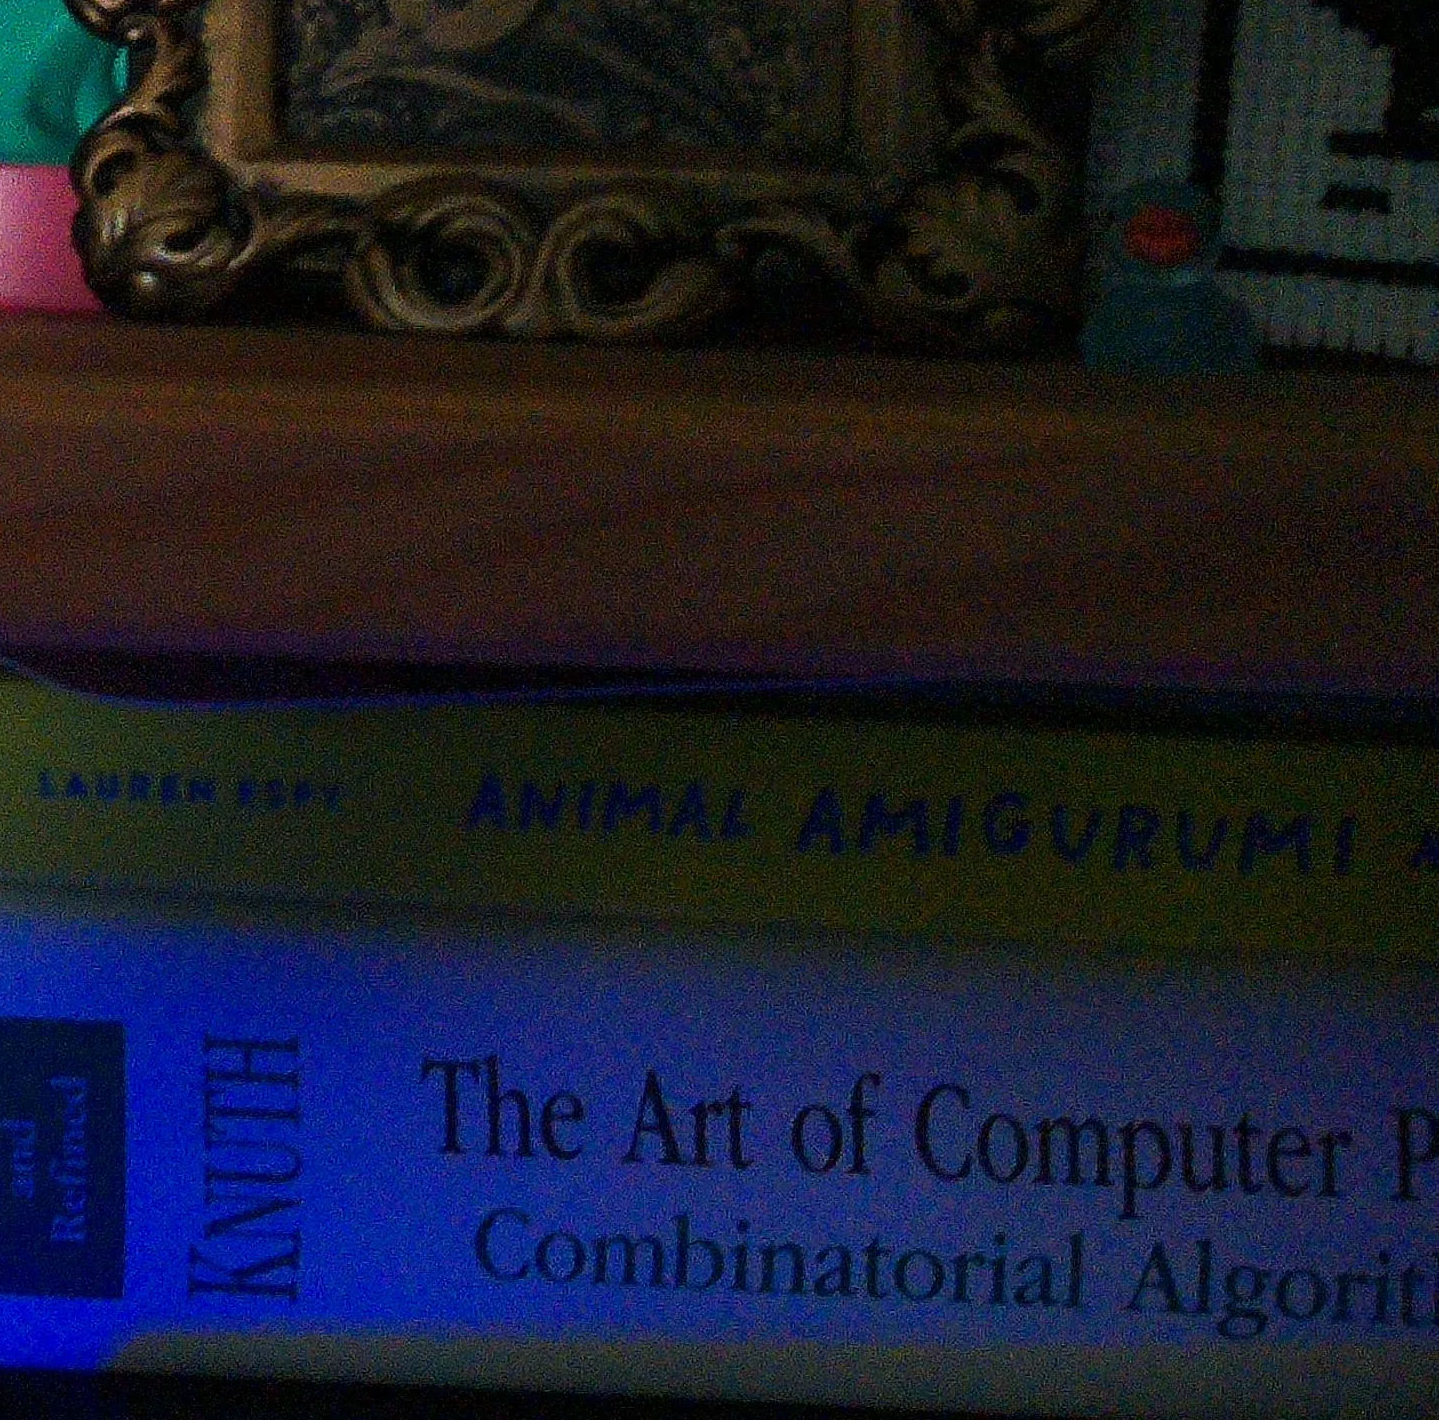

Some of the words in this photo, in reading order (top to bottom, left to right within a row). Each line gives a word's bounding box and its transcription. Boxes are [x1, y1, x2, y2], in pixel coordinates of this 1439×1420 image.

[38, 766, 219, 810] LAUREN
[464, 770, 752, 841] ANIMAL
[796, 786, 1359, 877] AMIGURUMI
[47, 1074, 90, 1246] Refined
[187, 1031, 303, 1305] KNUTH
[421, 1055, 584, 1165] The
[628, 1070, 749, 1172] Art
[790, 1072, 881, 1175] of
[914, 1081, 1353, 1218] Computer
[475, 1207, 1084, 1312] Combinatorial
